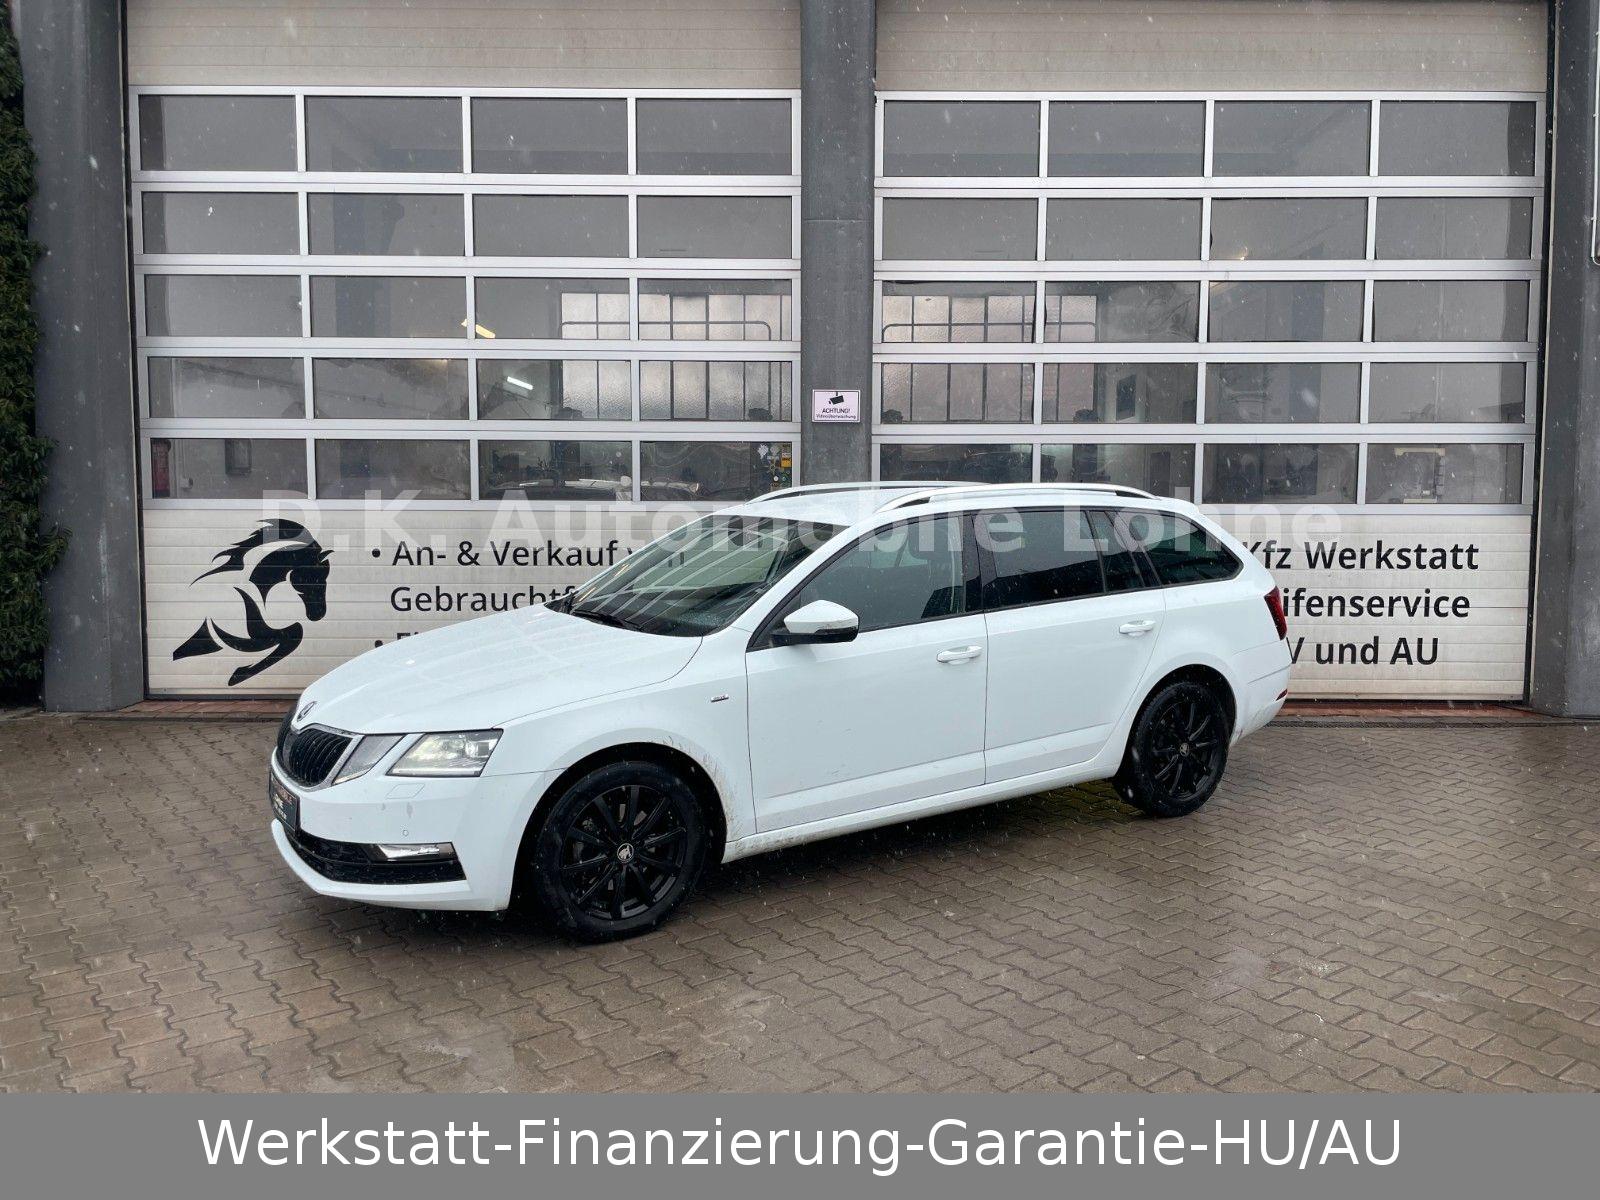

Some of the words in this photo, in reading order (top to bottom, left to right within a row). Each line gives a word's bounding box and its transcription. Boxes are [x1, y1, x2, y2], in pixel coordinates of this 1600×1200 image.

[392, 541, 447, 566] An-
[457, 540, 481, 567] &
[490, 539, 620, 567] Verkauf
[1304, 540, 1480, 570] Werkstatt
[1282, 587, 1471, 618] ifenservice
[1315, 635, 1380, 665] und
[1389, 637, 1440, 666] AU
